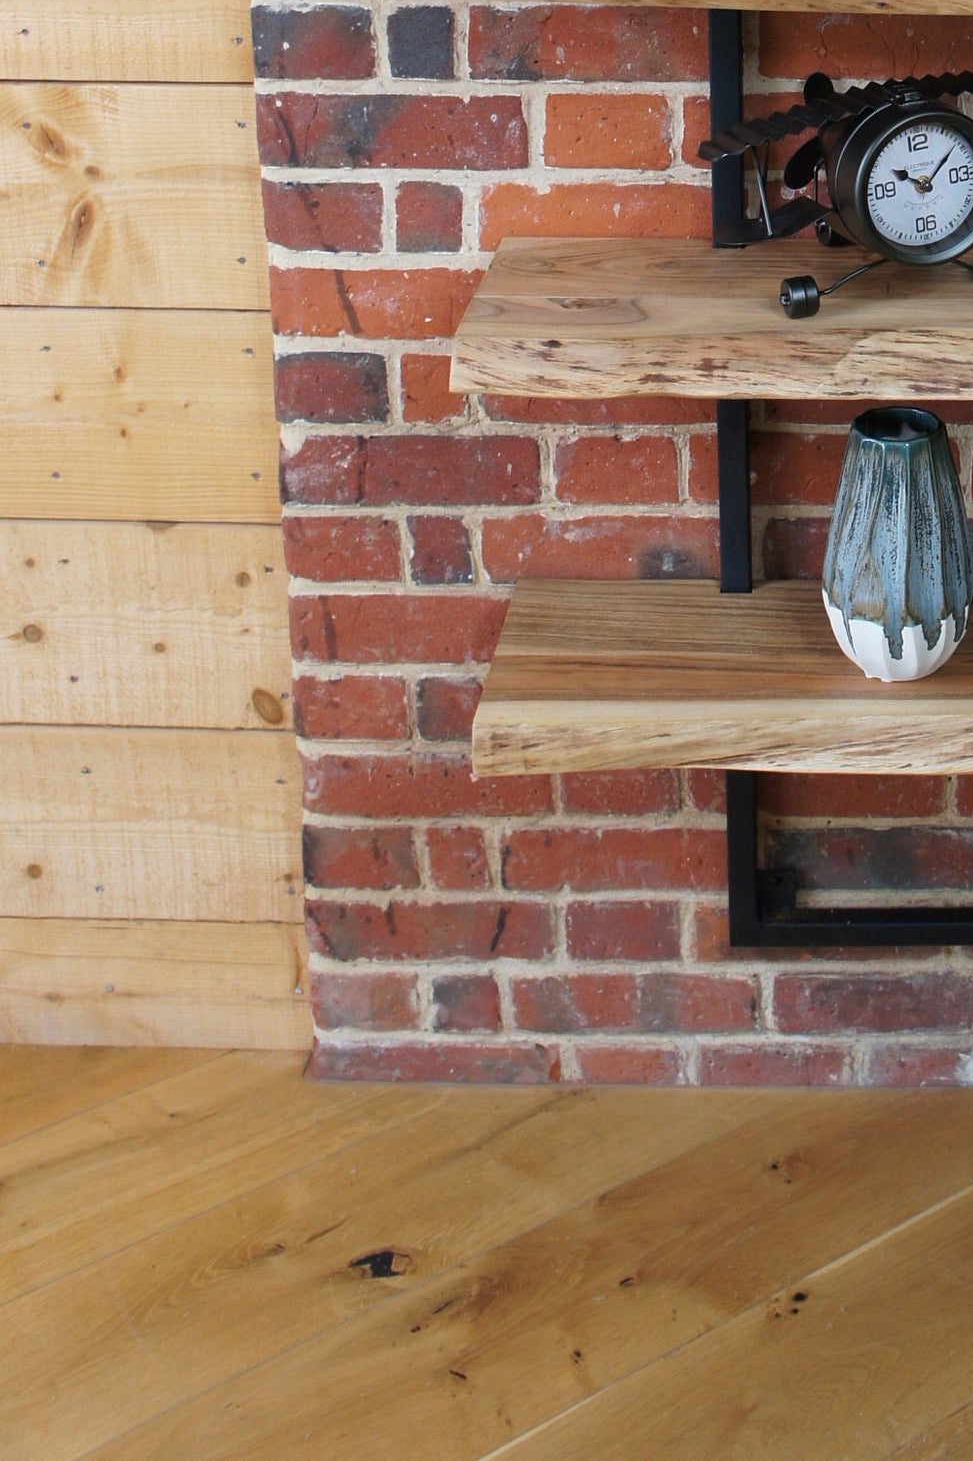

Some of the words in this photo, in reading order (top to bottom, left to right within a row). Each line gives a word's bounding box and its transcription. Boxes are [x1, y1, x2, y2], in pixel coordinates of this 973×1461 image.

[907, 133, 929, 153] 12
[949, 165, 970, 184] 03
[874, 181, 897, 200] 09
[915, 214, 937, 233] 06
